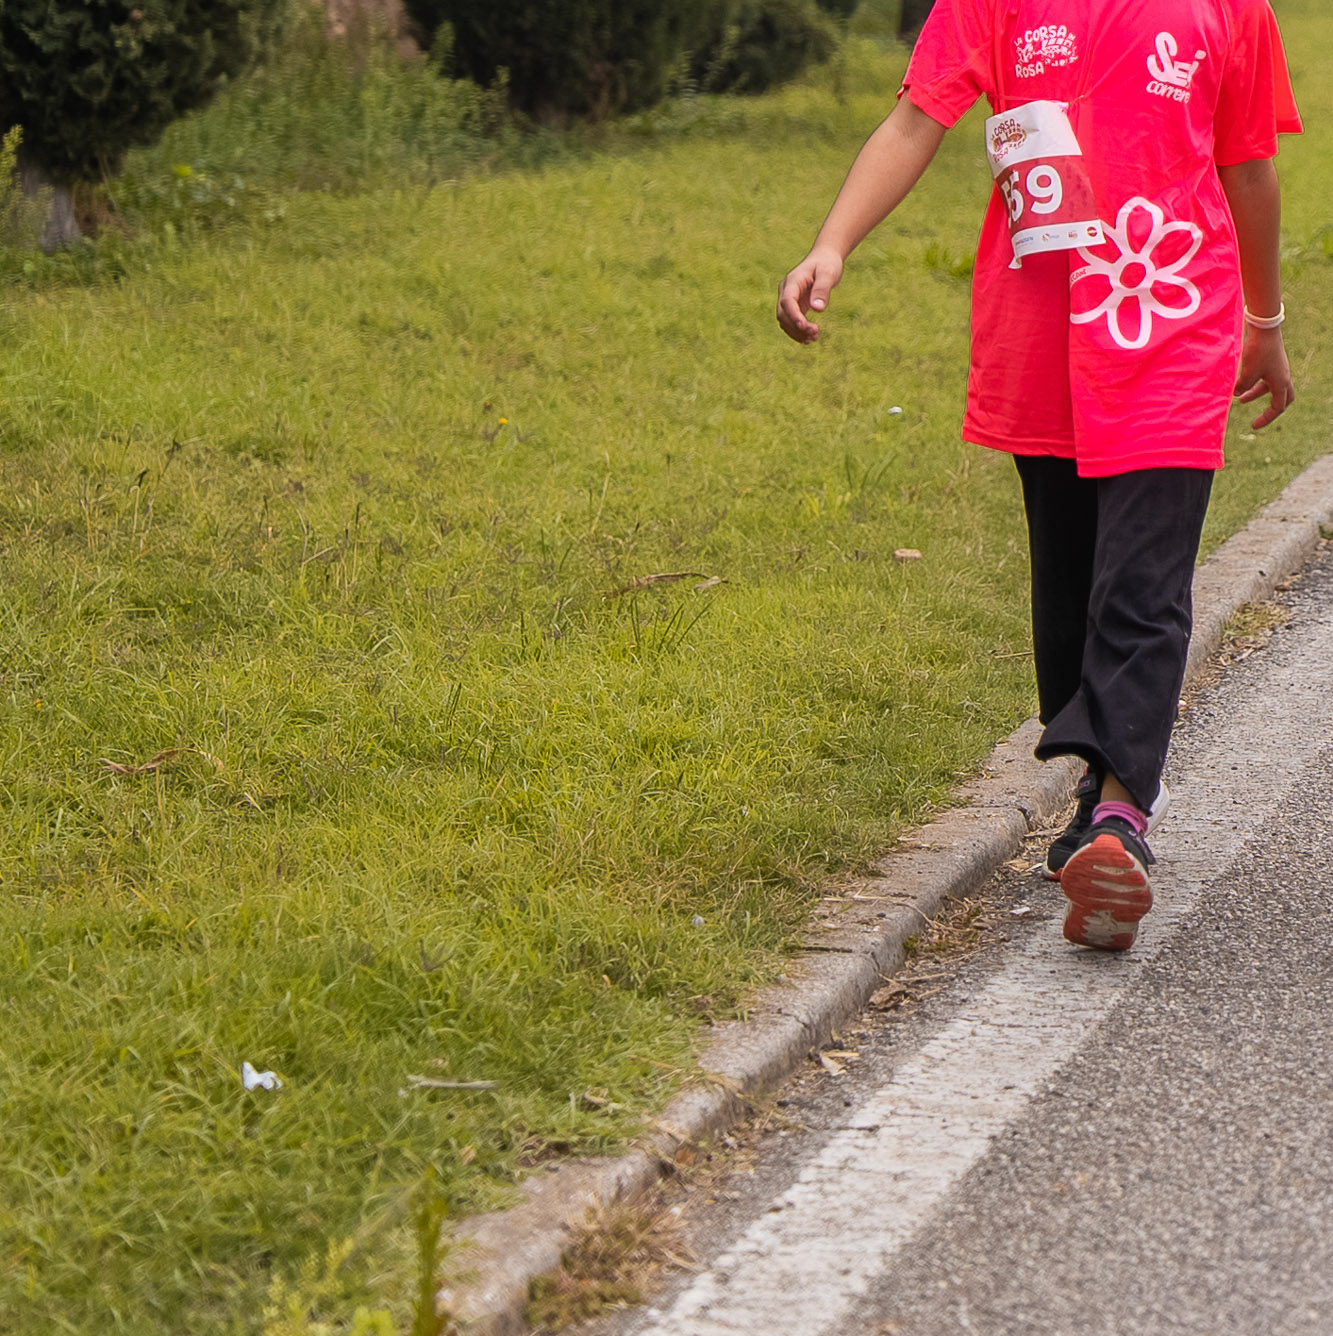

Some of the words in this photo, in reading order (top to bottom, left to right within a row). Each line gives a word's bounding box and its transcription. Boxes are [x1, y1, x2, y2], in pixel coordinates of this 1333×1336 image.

[1024, 24, 1068, 43] CORSA
[1015, 61, 1045, 79] ROSA
[993, 118, 1016, 137] CORSA
